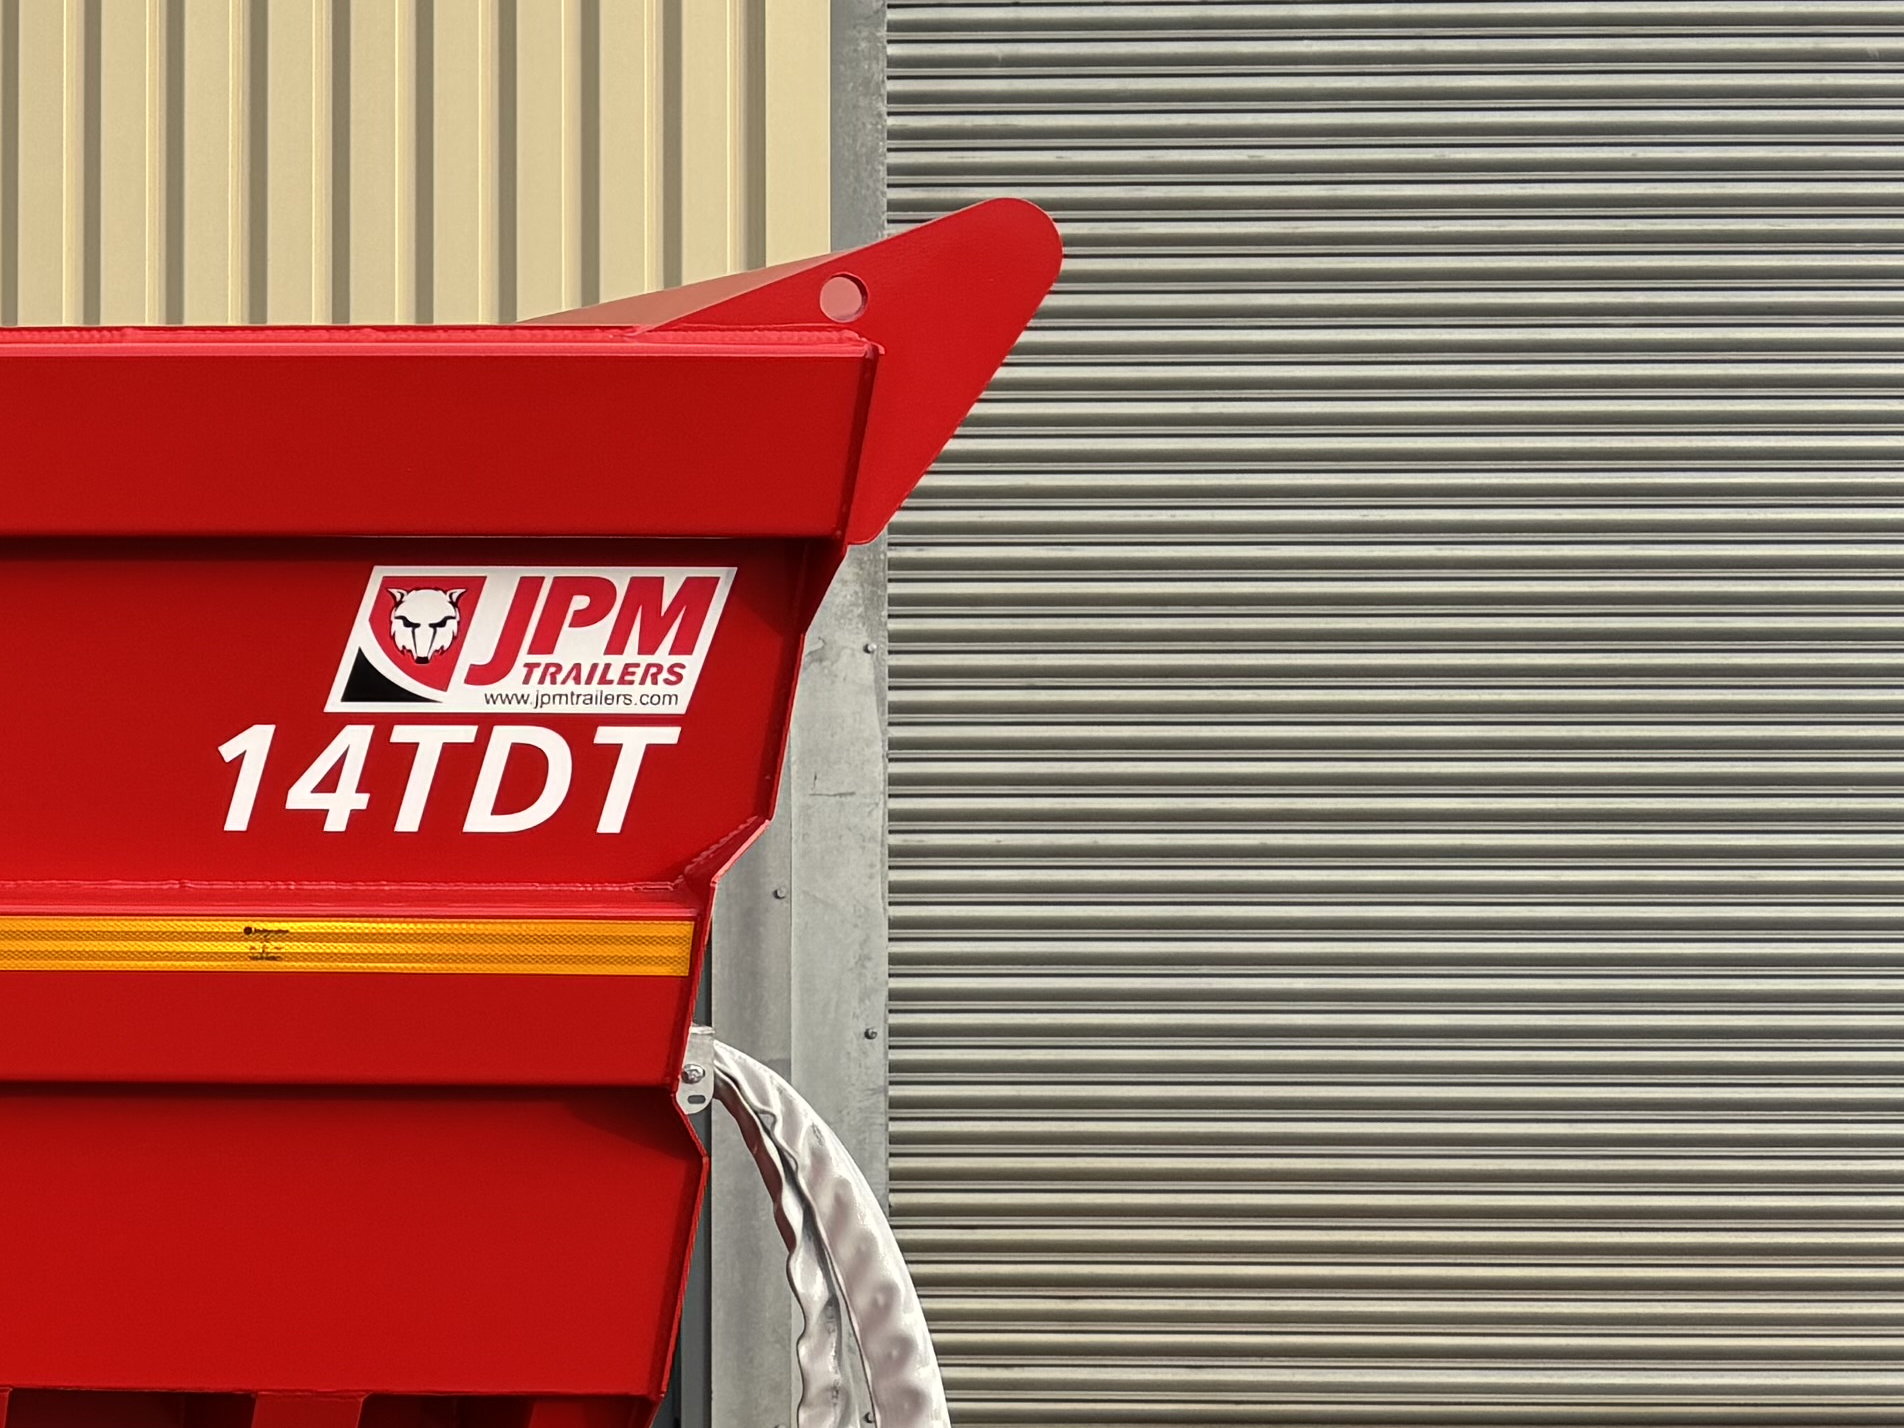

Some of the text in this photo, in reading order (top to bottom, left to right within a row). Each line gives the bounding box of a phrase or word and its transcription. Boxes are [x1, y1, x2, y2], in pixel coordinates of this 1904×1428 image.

[464, 575, 721, 686] JPM
[484, 688, 680, 710] www.jpmtrailers.com
[521, 661, 686, 687] TRAILERS
[217, 724, 682, 834] 14TDT
